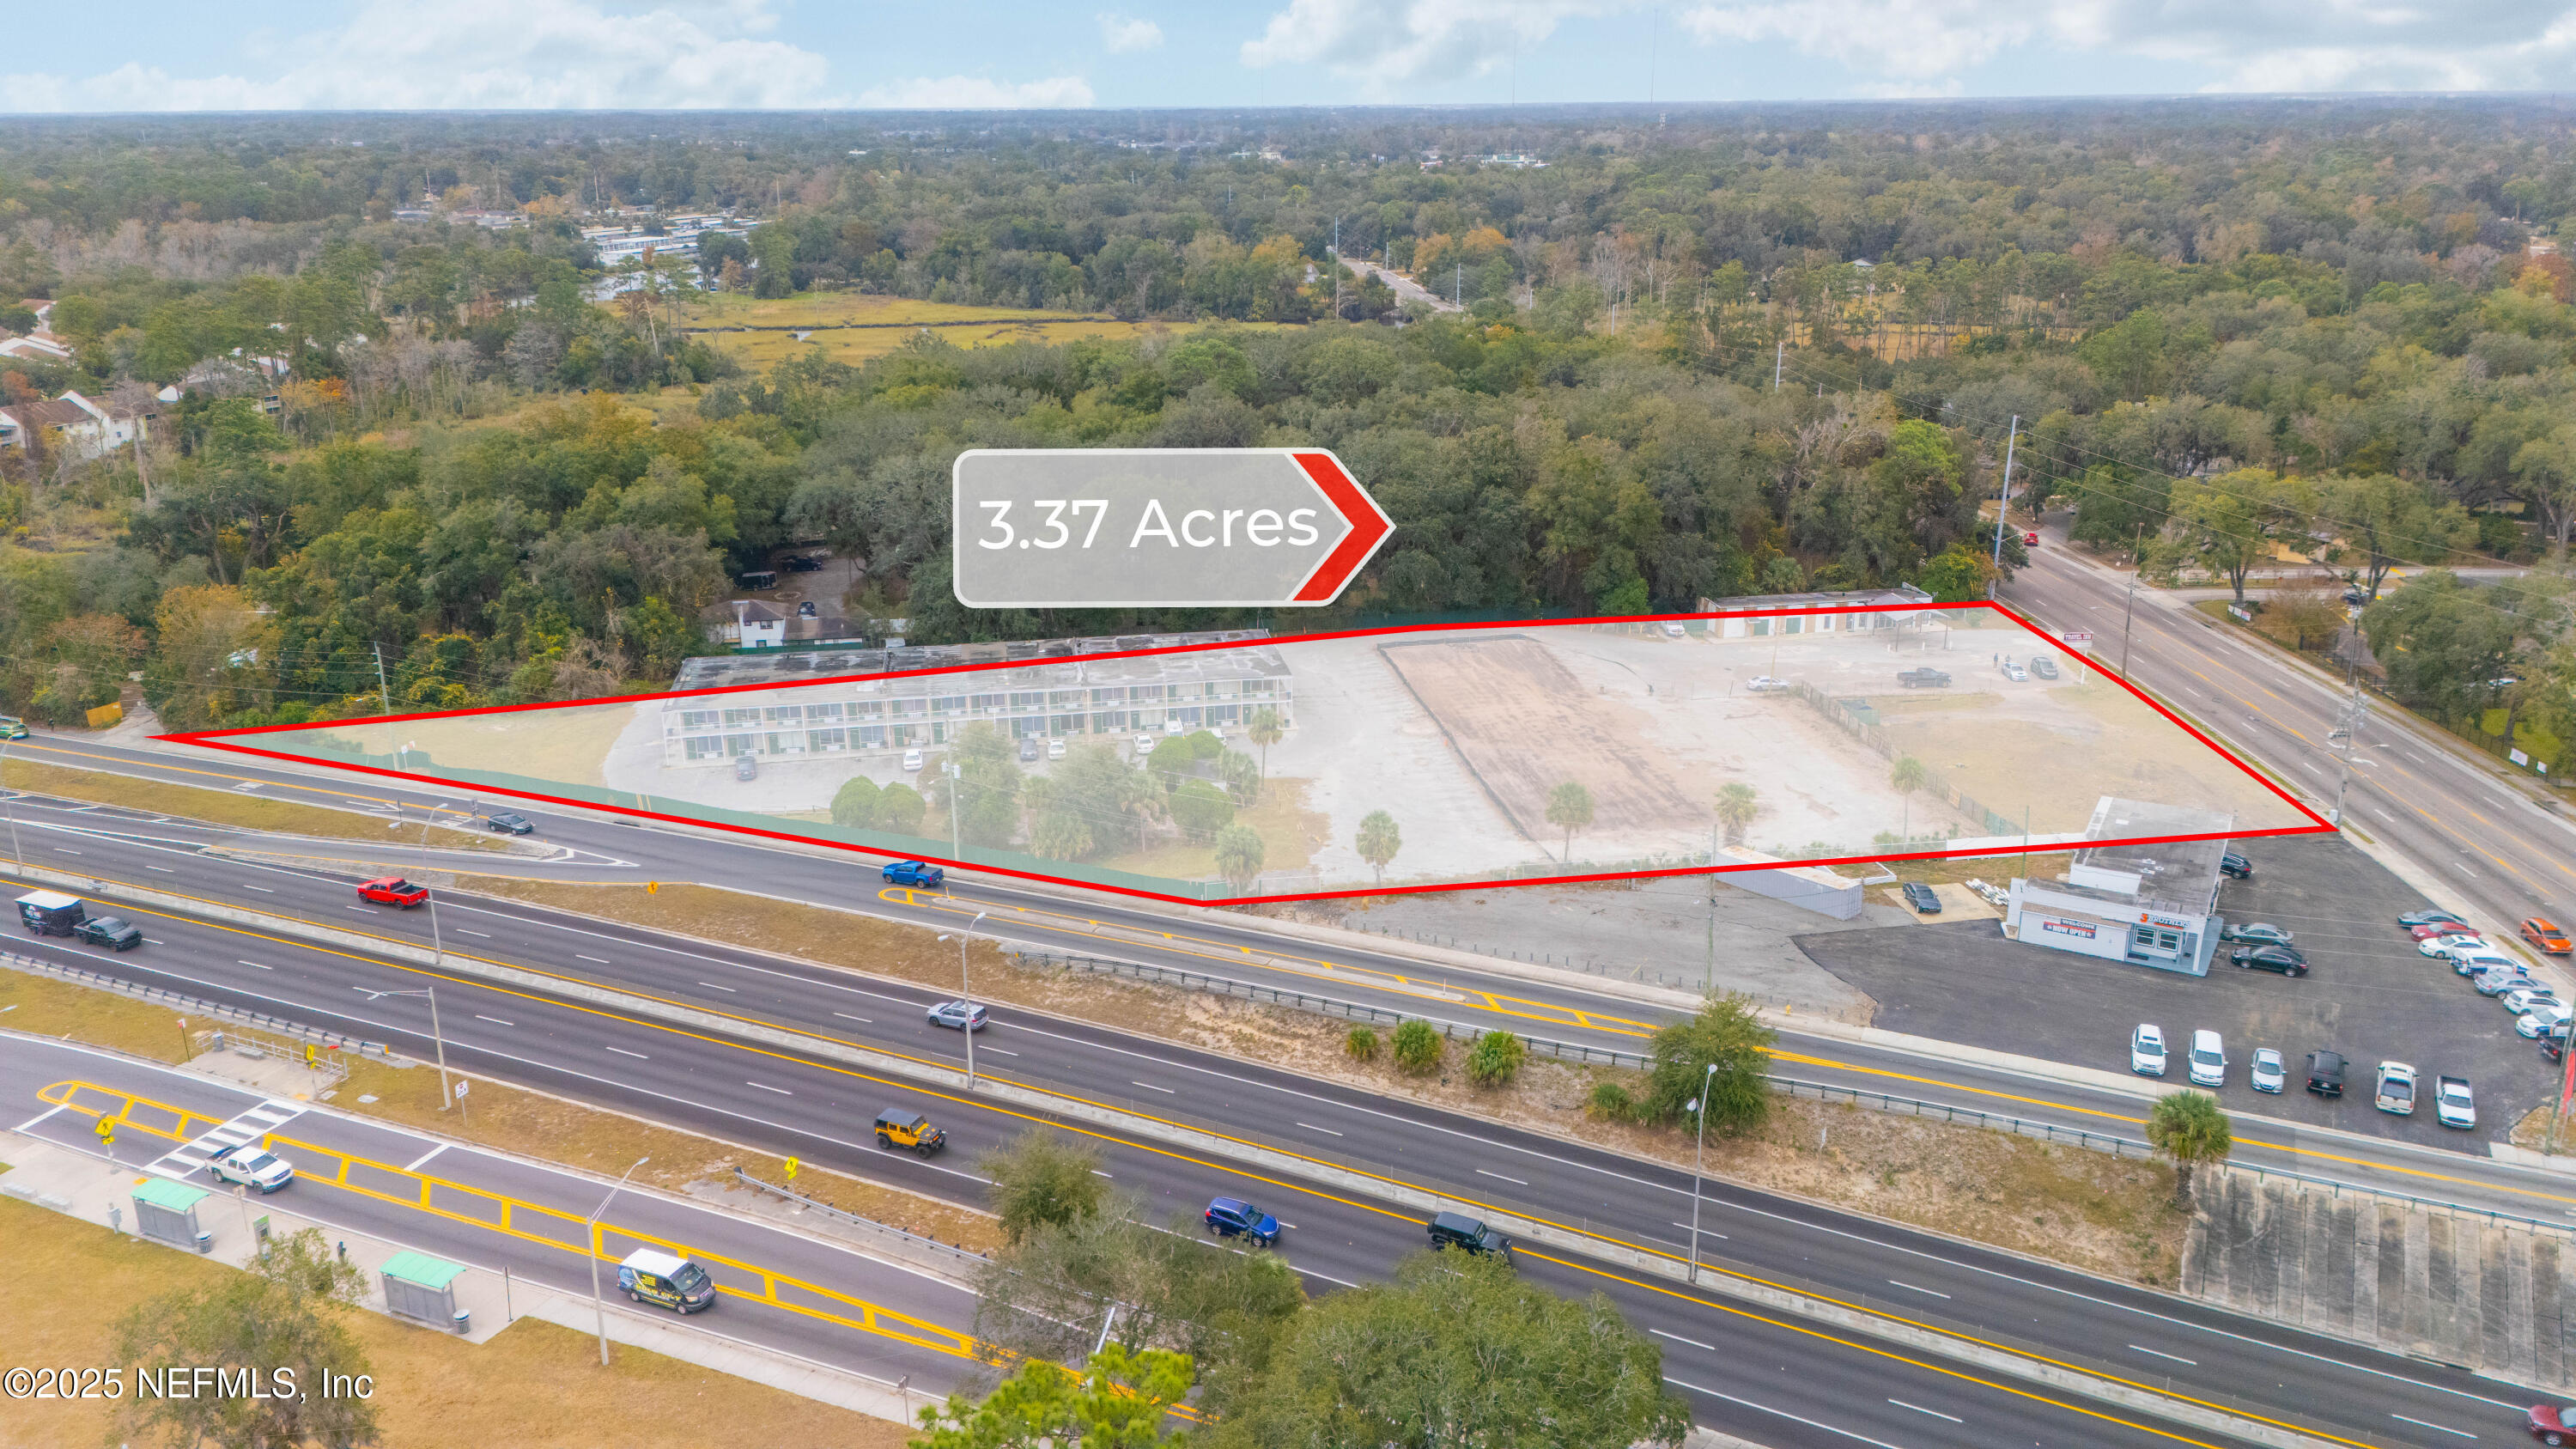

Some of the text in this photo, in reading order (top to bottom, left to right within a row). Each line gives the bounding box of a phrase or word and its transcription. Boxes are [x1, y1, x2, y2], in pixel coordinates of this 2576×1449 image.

[2062, 919, 2095, 929] WELCOME
[2140, 913, 2148, 923] 3
[2148, 915, 2190, 928] BROTHERS
[2052, 925, 2087, 937] NOW OPEN
